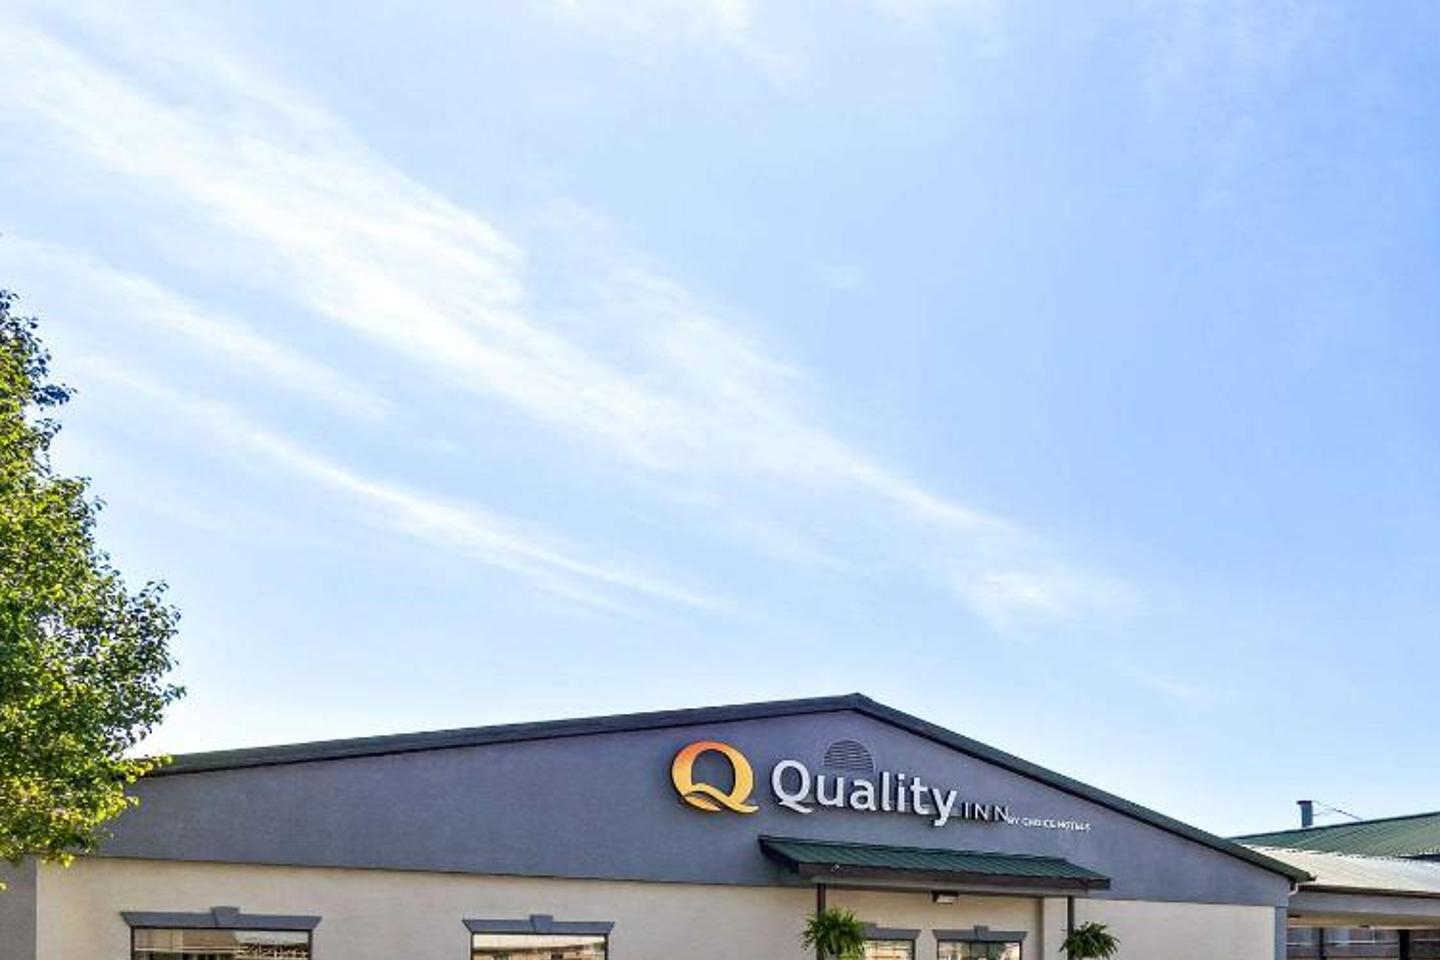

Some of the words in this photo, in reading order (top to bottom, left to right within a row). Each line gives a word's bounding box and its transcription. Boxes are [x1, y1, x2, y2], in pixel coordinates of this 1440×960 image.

[671, 740, 759, 813] Q
[771, 759, 957, 826] Quality
[964, 802, 1009, 821] INN
